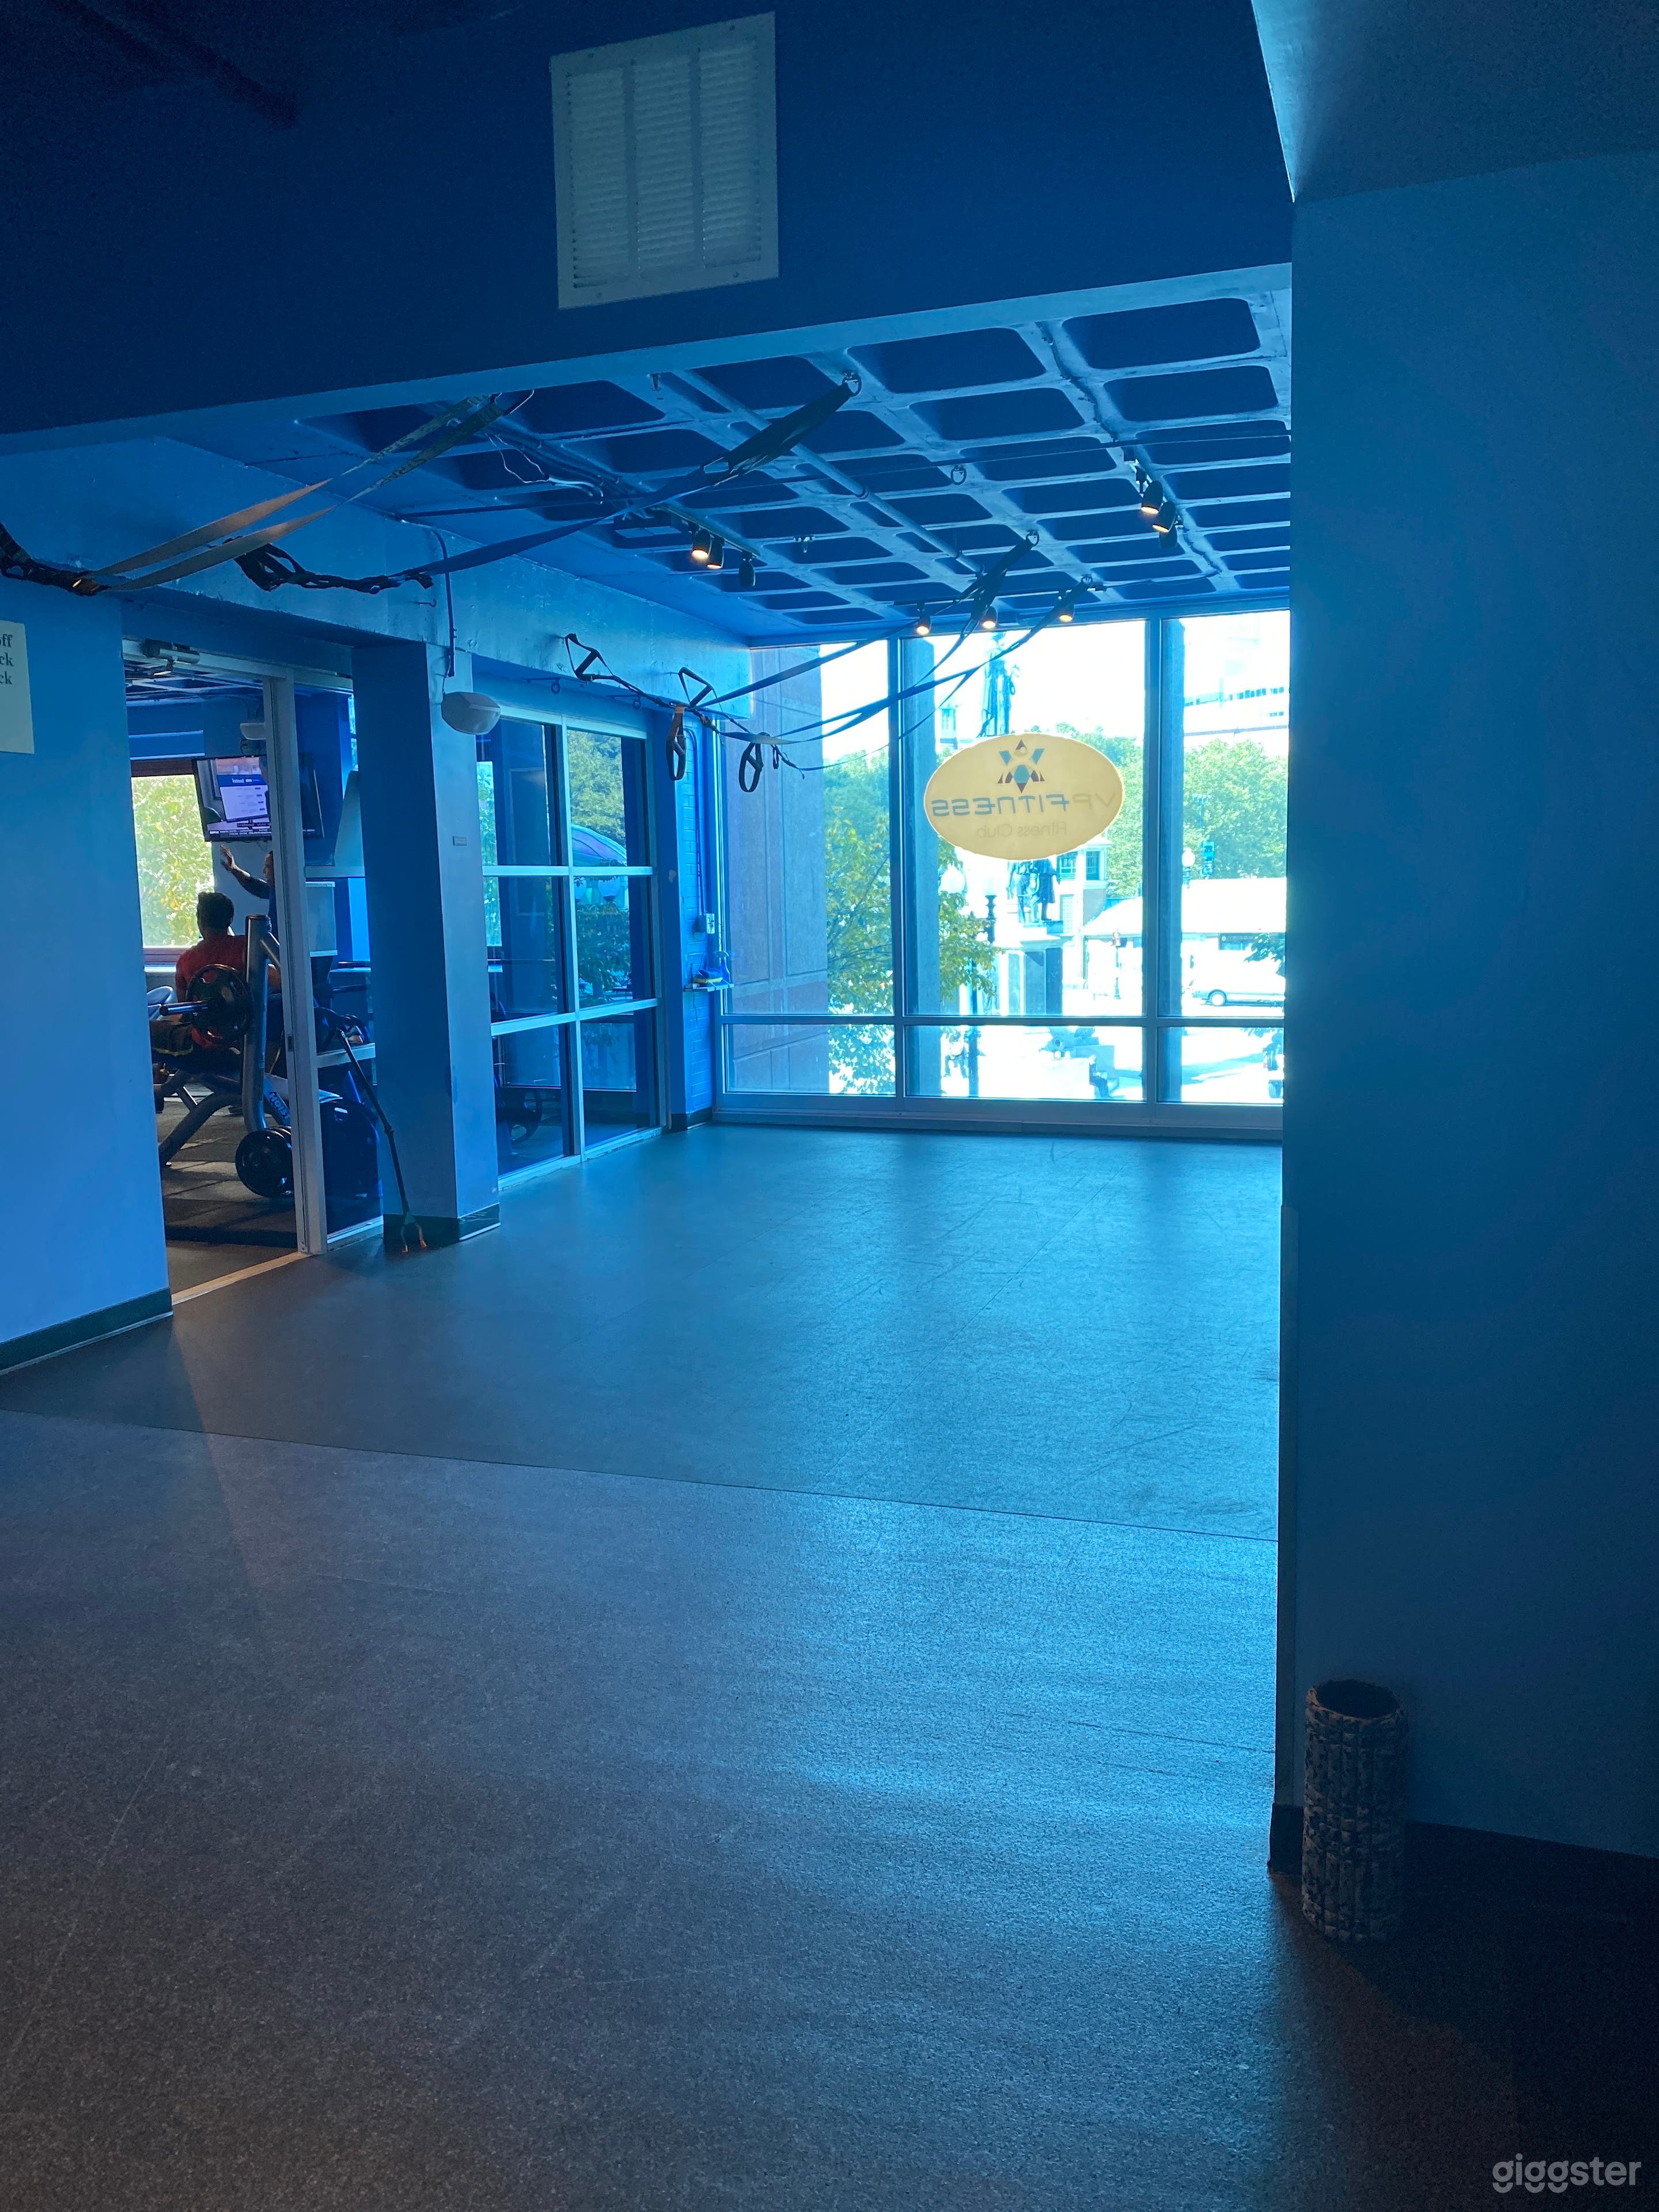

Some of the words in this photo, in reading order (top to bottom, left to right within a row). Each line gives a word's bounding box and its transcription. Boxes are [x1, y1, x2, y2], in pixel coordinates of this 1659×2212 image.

[0, 634, 13, 647] ff
[0, 652, 13, 667] ck
[0, 671, 12, 685] ck
